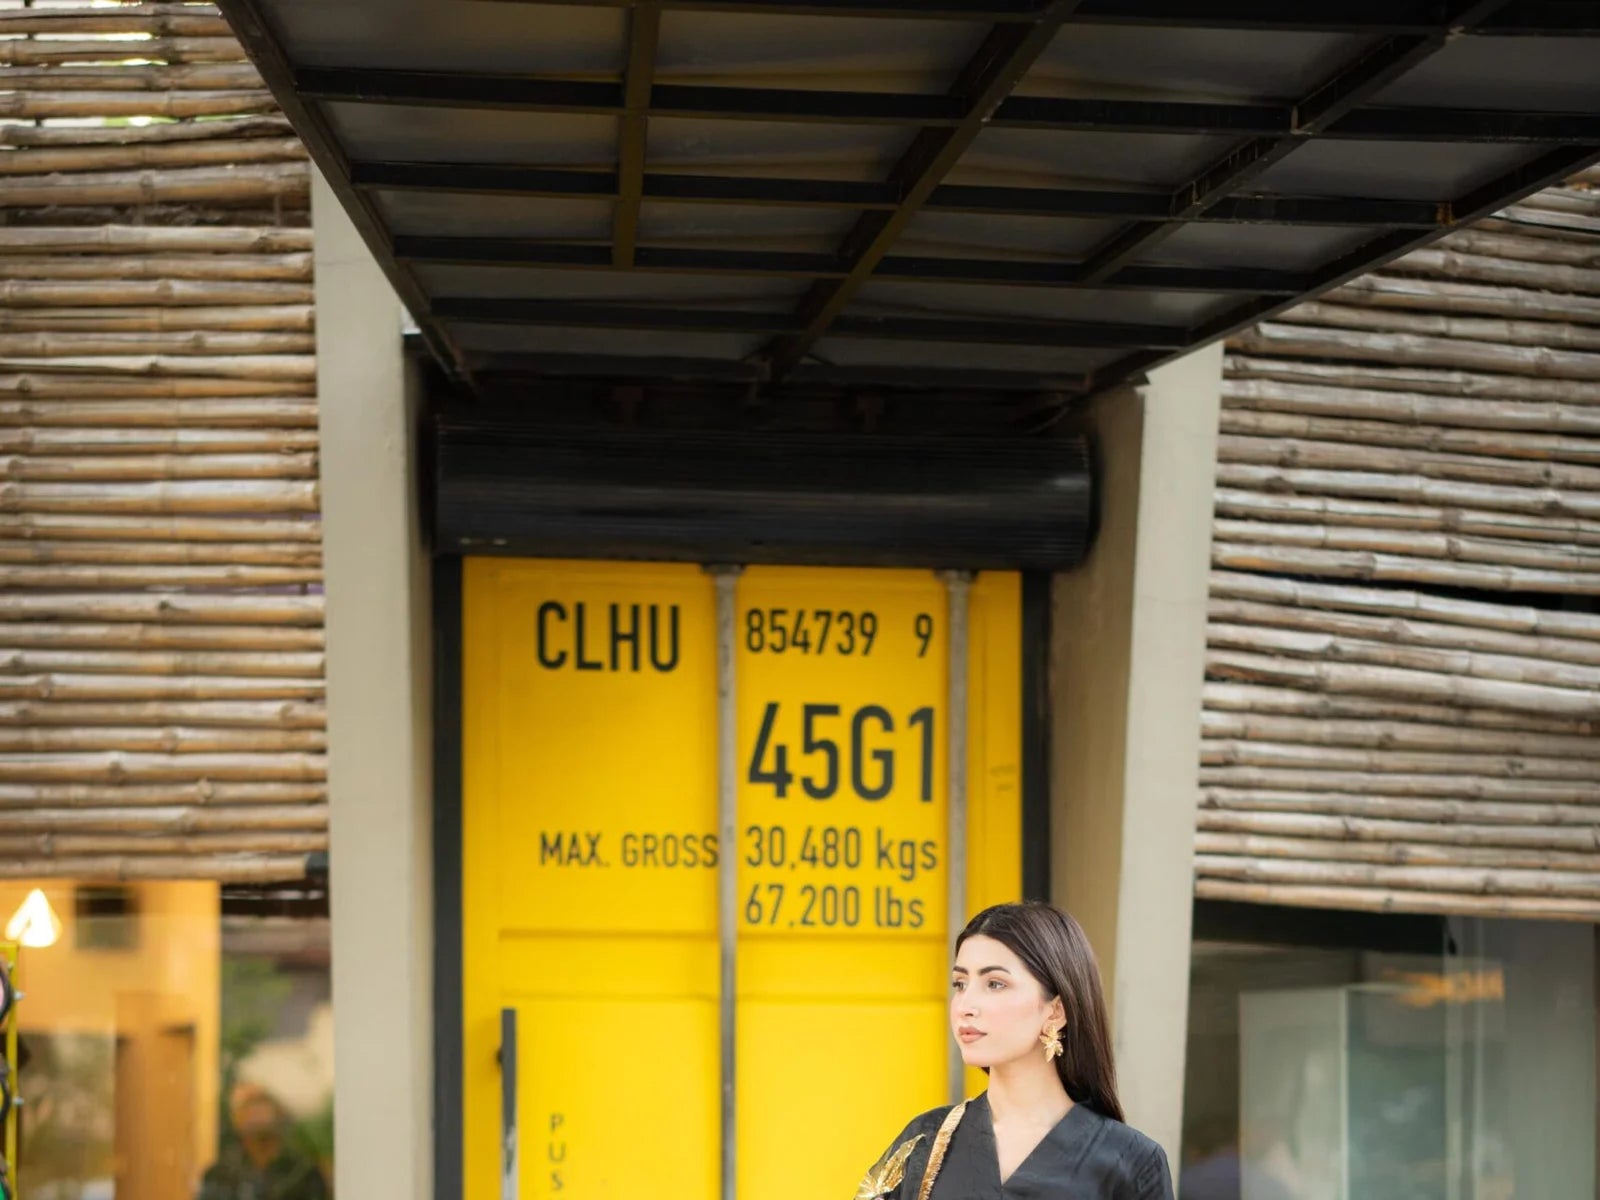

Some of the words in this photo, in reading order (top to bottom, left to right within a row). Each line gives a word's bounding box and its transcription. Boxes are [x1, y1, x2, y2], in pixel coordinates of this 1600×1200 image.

[535, 599, 681, 674] CLHU
[745, 607, 879, 656] 854739
[913, 612, 935, 658] 9
[747, 701, 936, 804] 45G1
[539, 831, 609, 868] MAX.
[621, 833, 718, 868] GROSS
[876, 829, 938, 882] kgs
[874, 883, 925, 928] lbs
